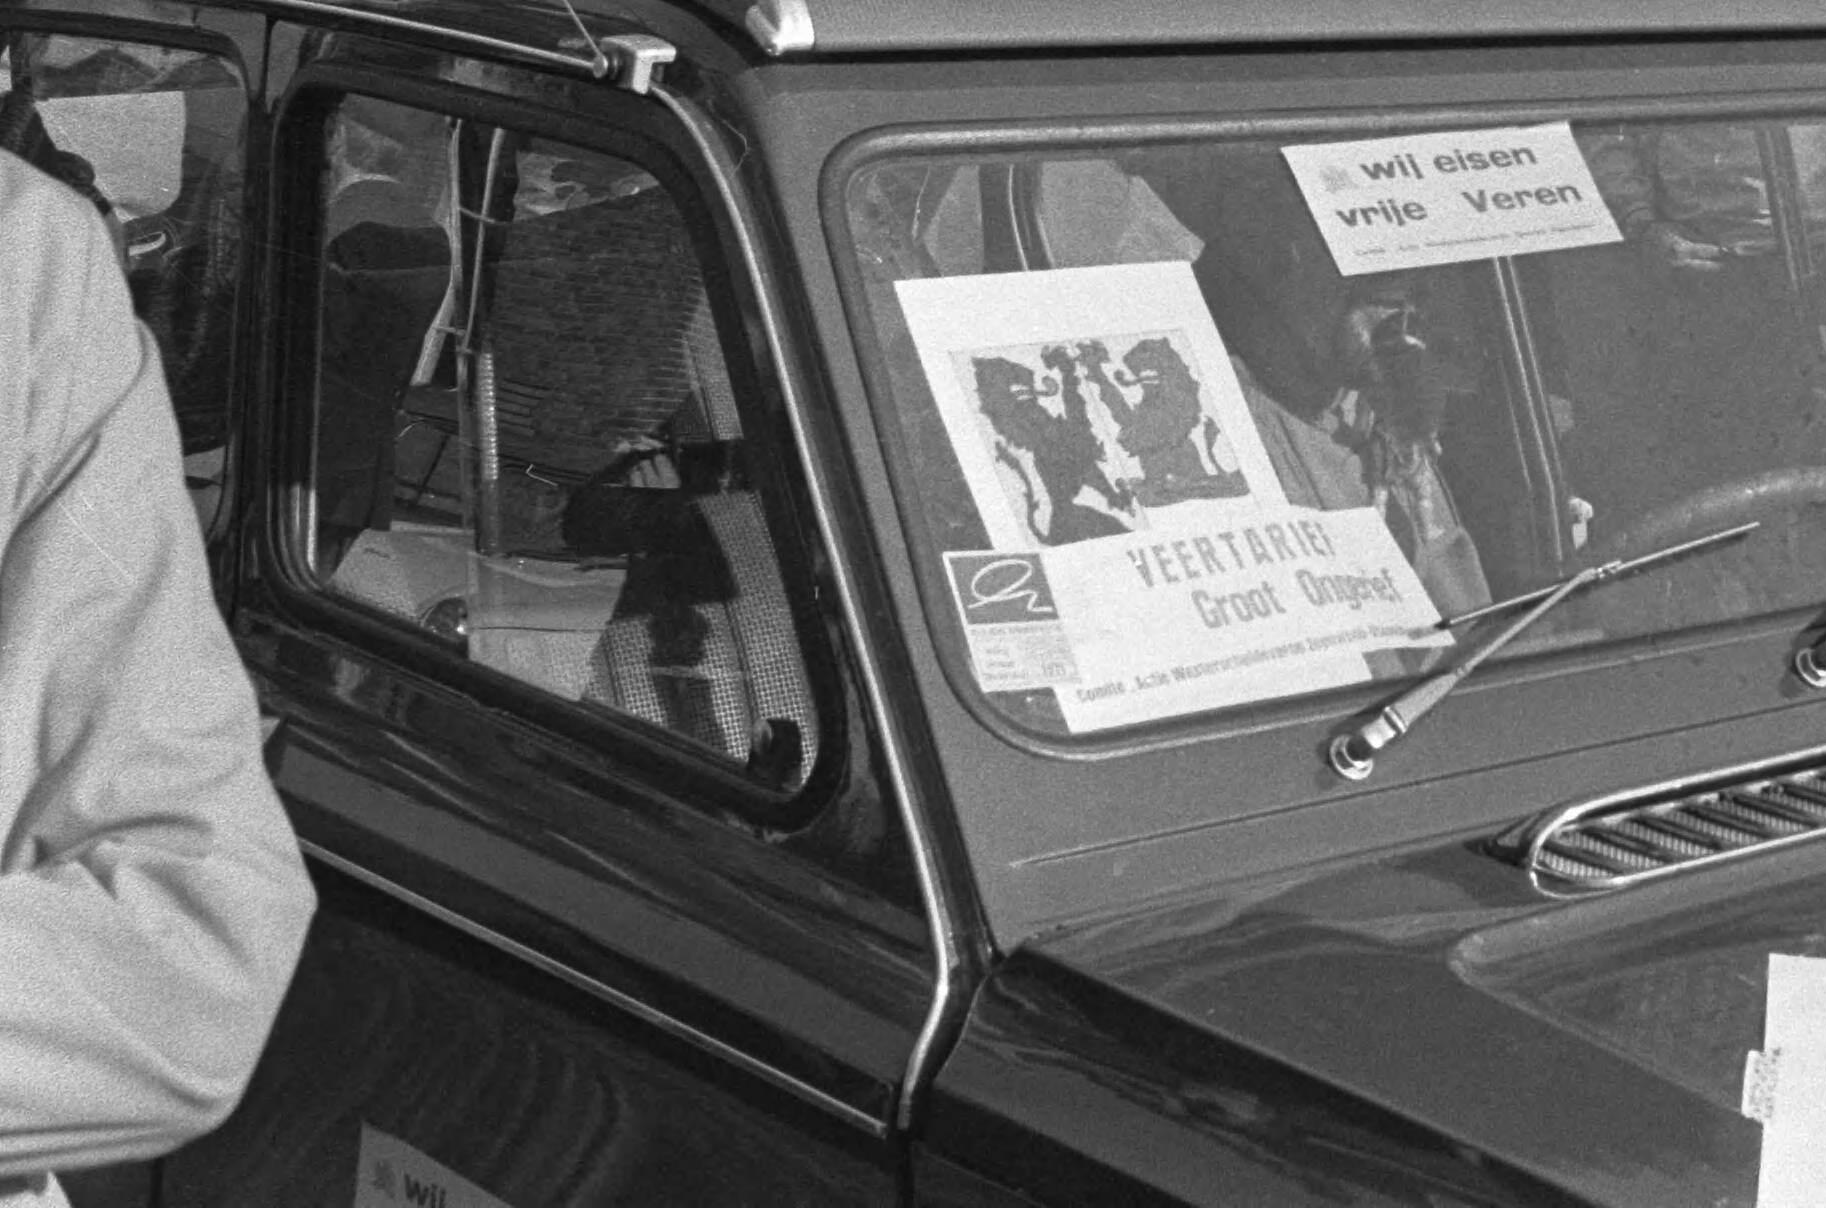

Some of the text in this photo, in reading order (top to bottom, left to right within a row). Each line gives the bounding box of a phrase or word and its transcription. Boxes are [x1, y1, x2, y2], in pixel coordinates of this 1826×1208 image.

[1359, 146, 1537, 180] wij eisen
[1336, 185, 1583, 227] vrije Veren
[1191, 581, 1287, 629] Groot
